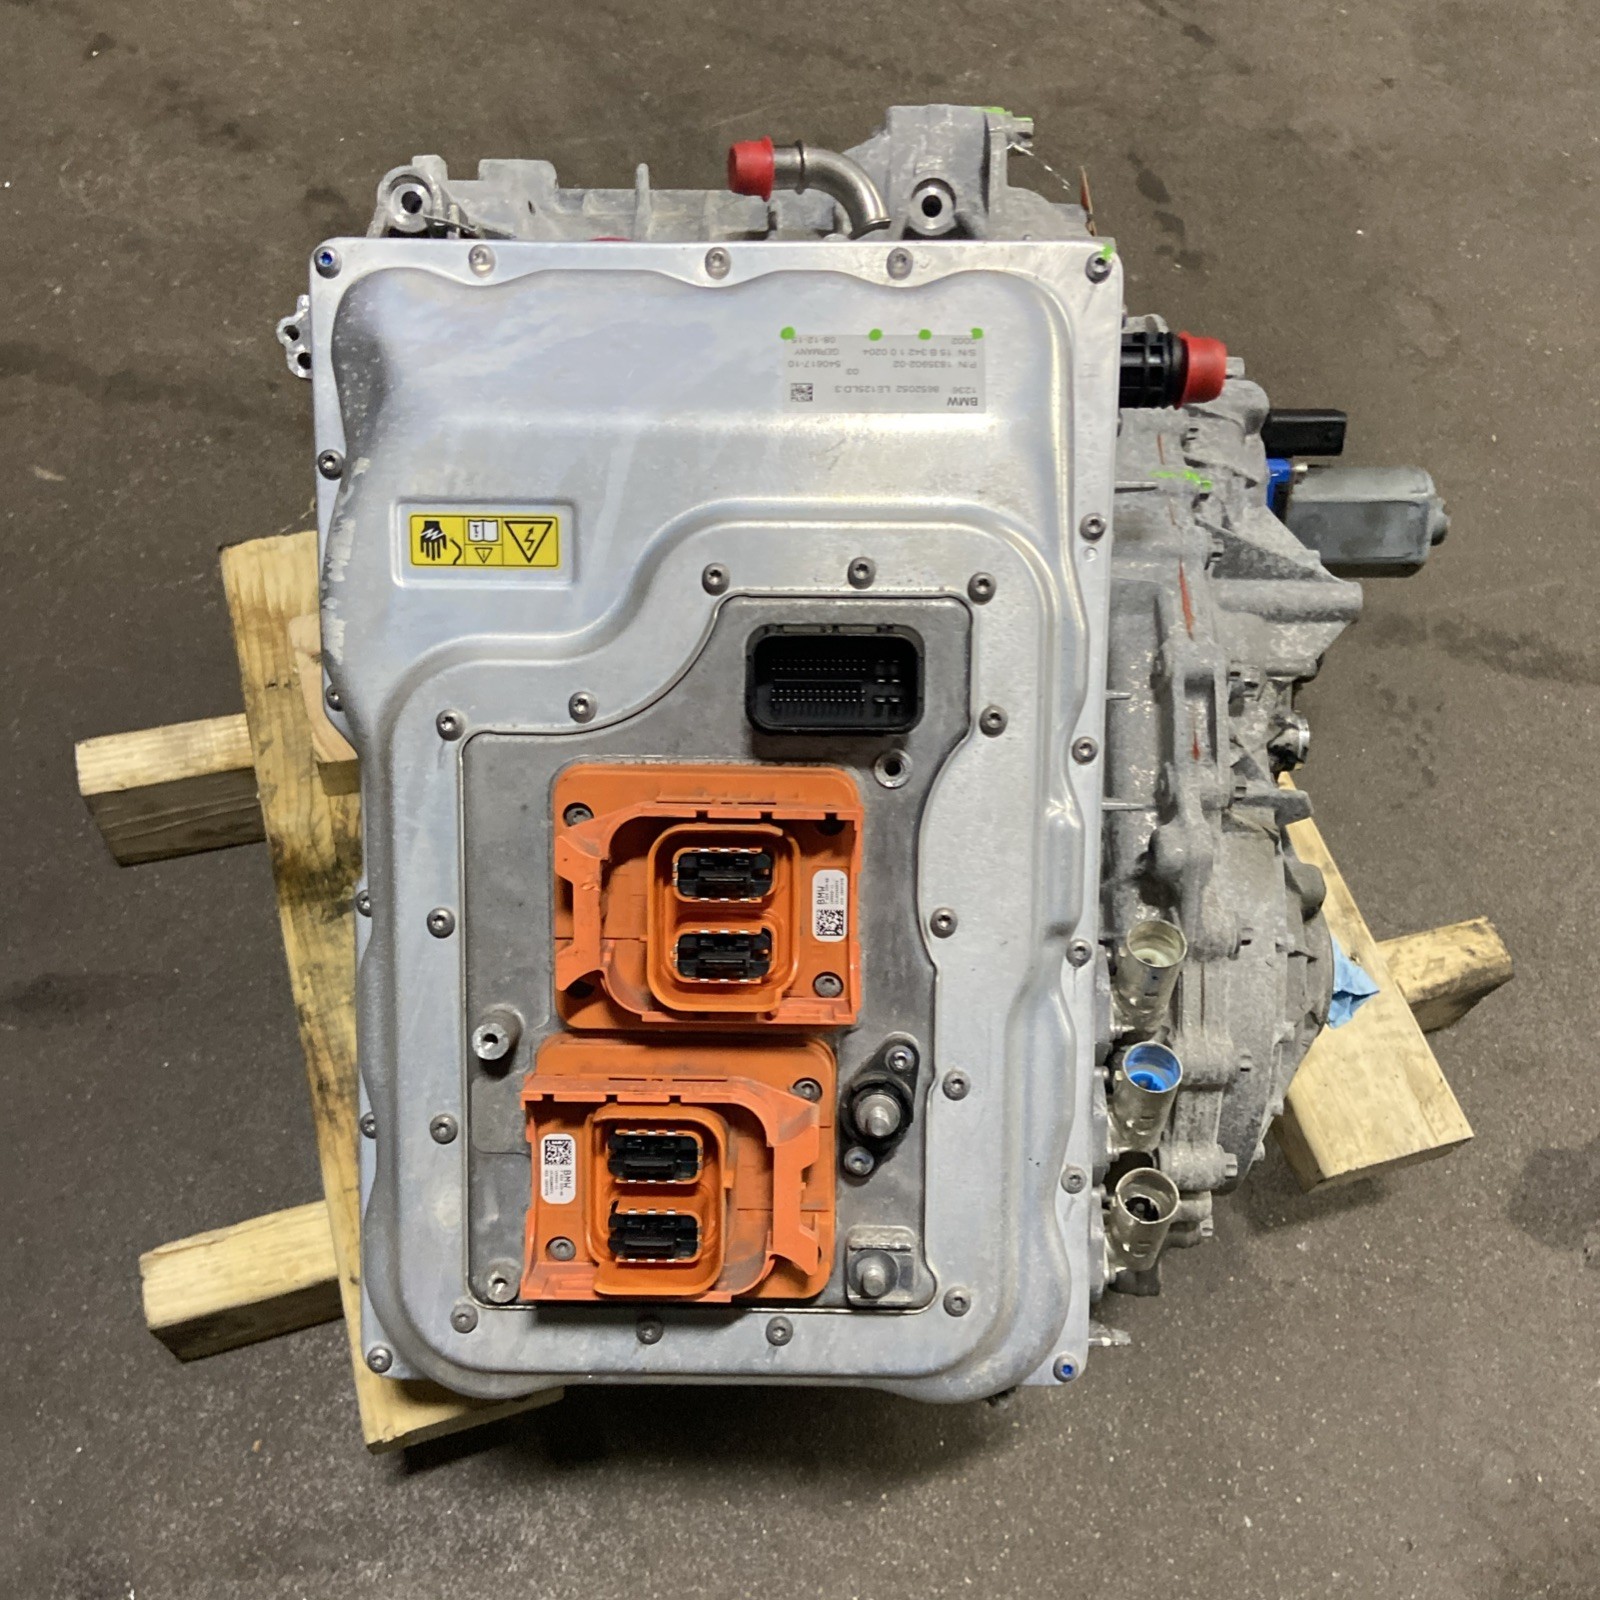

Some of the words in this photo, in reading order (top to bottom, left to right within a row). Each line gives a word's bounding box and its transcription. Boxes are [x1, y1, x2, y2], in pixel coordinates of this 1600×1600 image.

[794, 348, 840, 356] GERMANY
[947, 397, 978, 406] BMW
[816, 886, 825, 905] BMW
[563, 1169, 572, 1189] BMW
